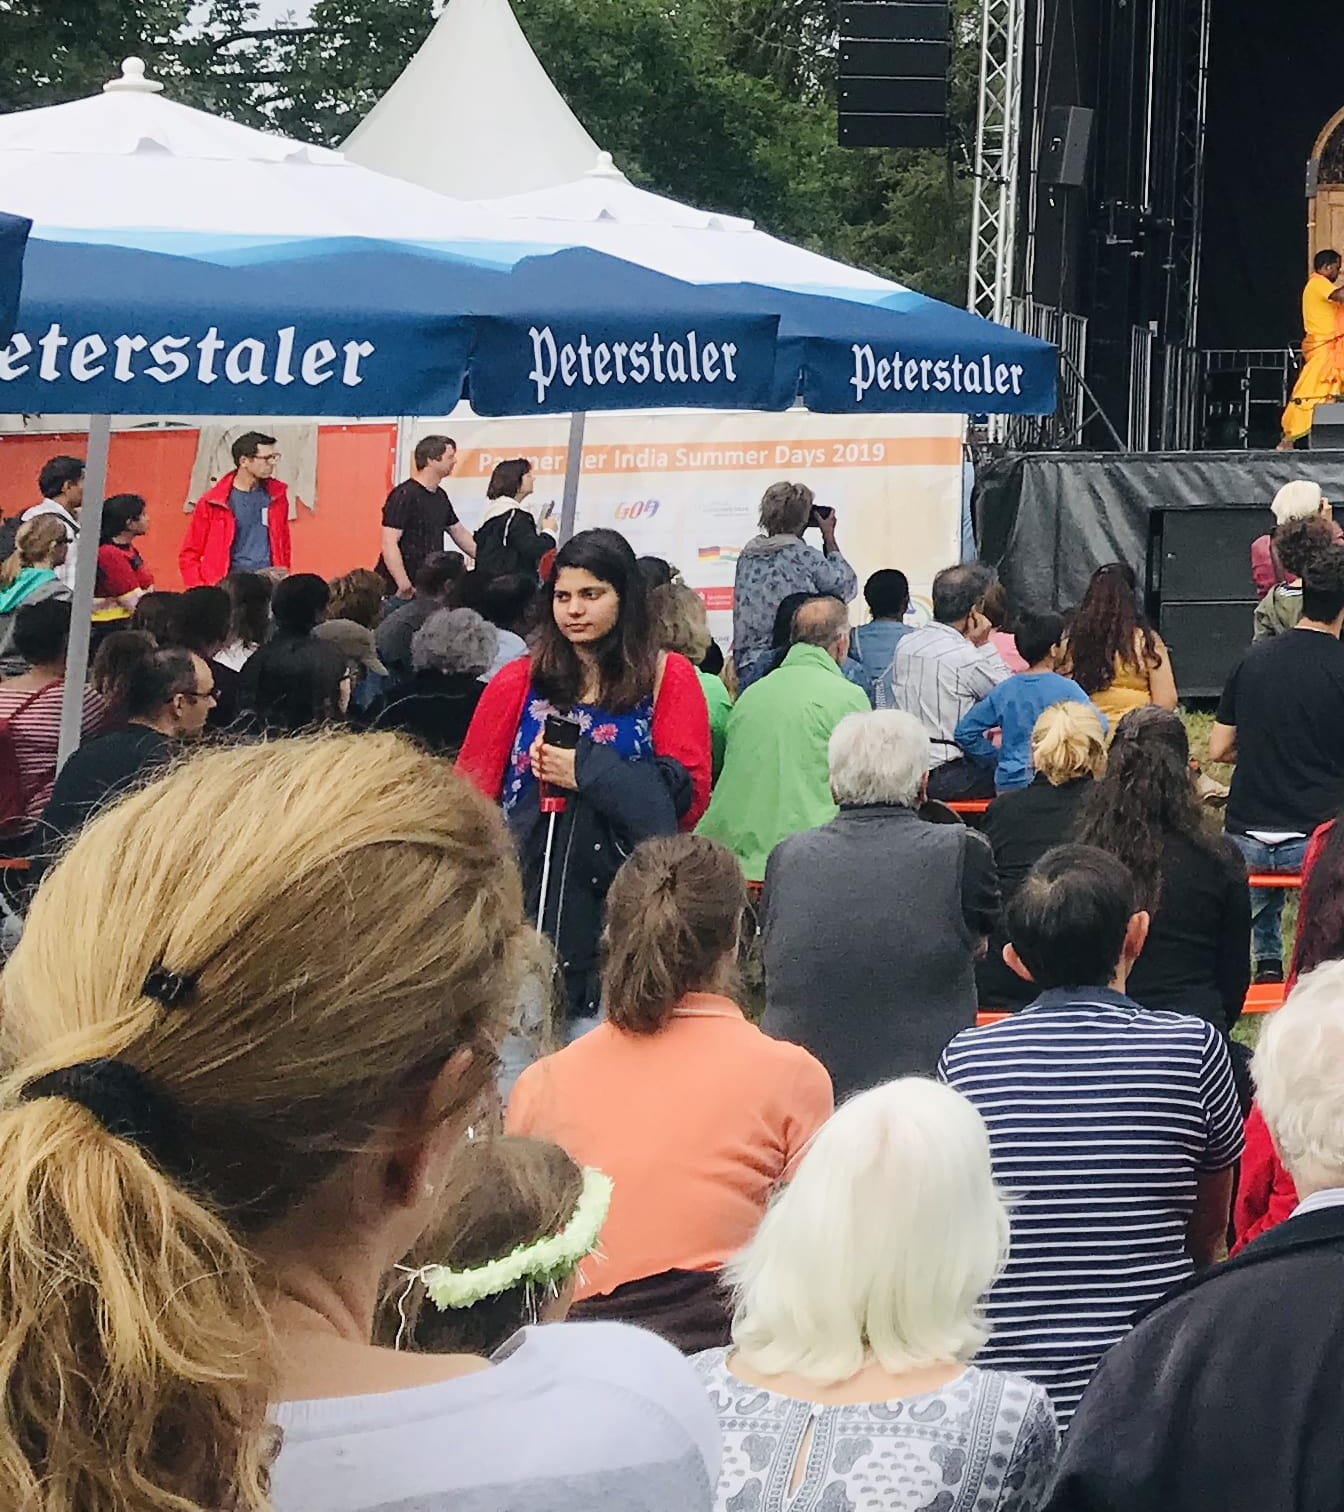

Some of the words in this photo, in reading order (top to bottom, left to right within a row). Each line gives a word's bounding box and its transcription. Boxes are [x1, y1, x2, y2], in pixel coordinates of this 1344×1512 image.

[0, 324, 375, 386] eterstaler
[529, 327, 737, 403] Peterstaler
[849, 344, 1023, 401] Peterstaler
[614, 448, 668, 468] India
[676, 445, 768, 466] Summer
[775, 443, 825, 468] Days
[832, 443, 885, 463] 2019
